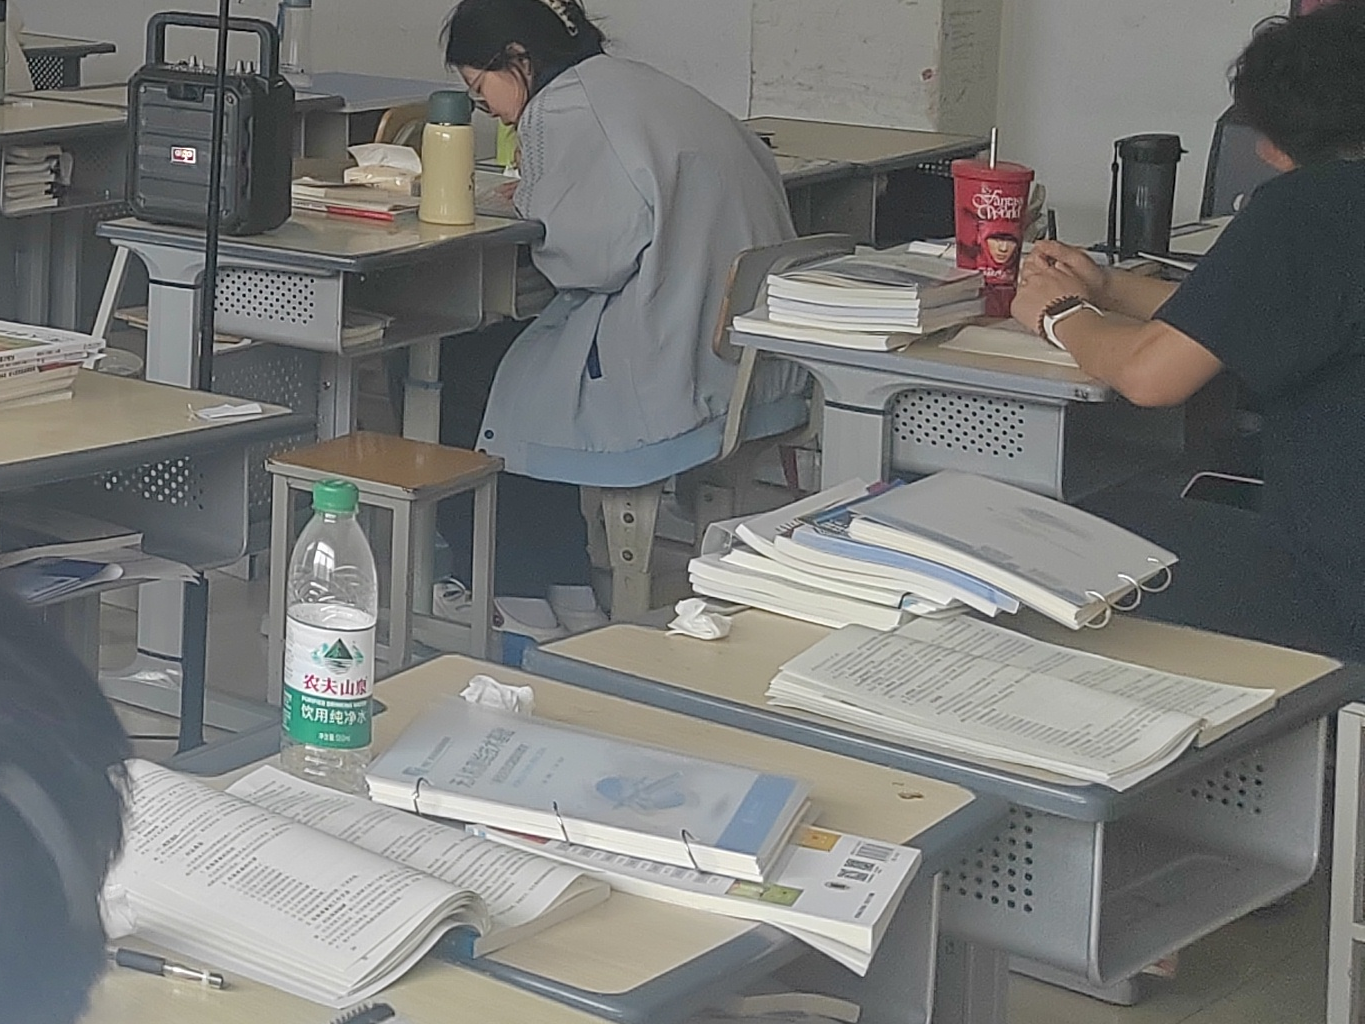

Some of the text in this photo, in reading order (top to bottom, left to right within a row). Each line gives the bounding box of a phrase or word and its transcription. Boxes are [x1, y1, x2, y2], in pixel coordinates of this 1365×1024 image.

[303, 674, 367, 696] 农夫山泉
[301, 703, 367, 726] 饮用纯净水
